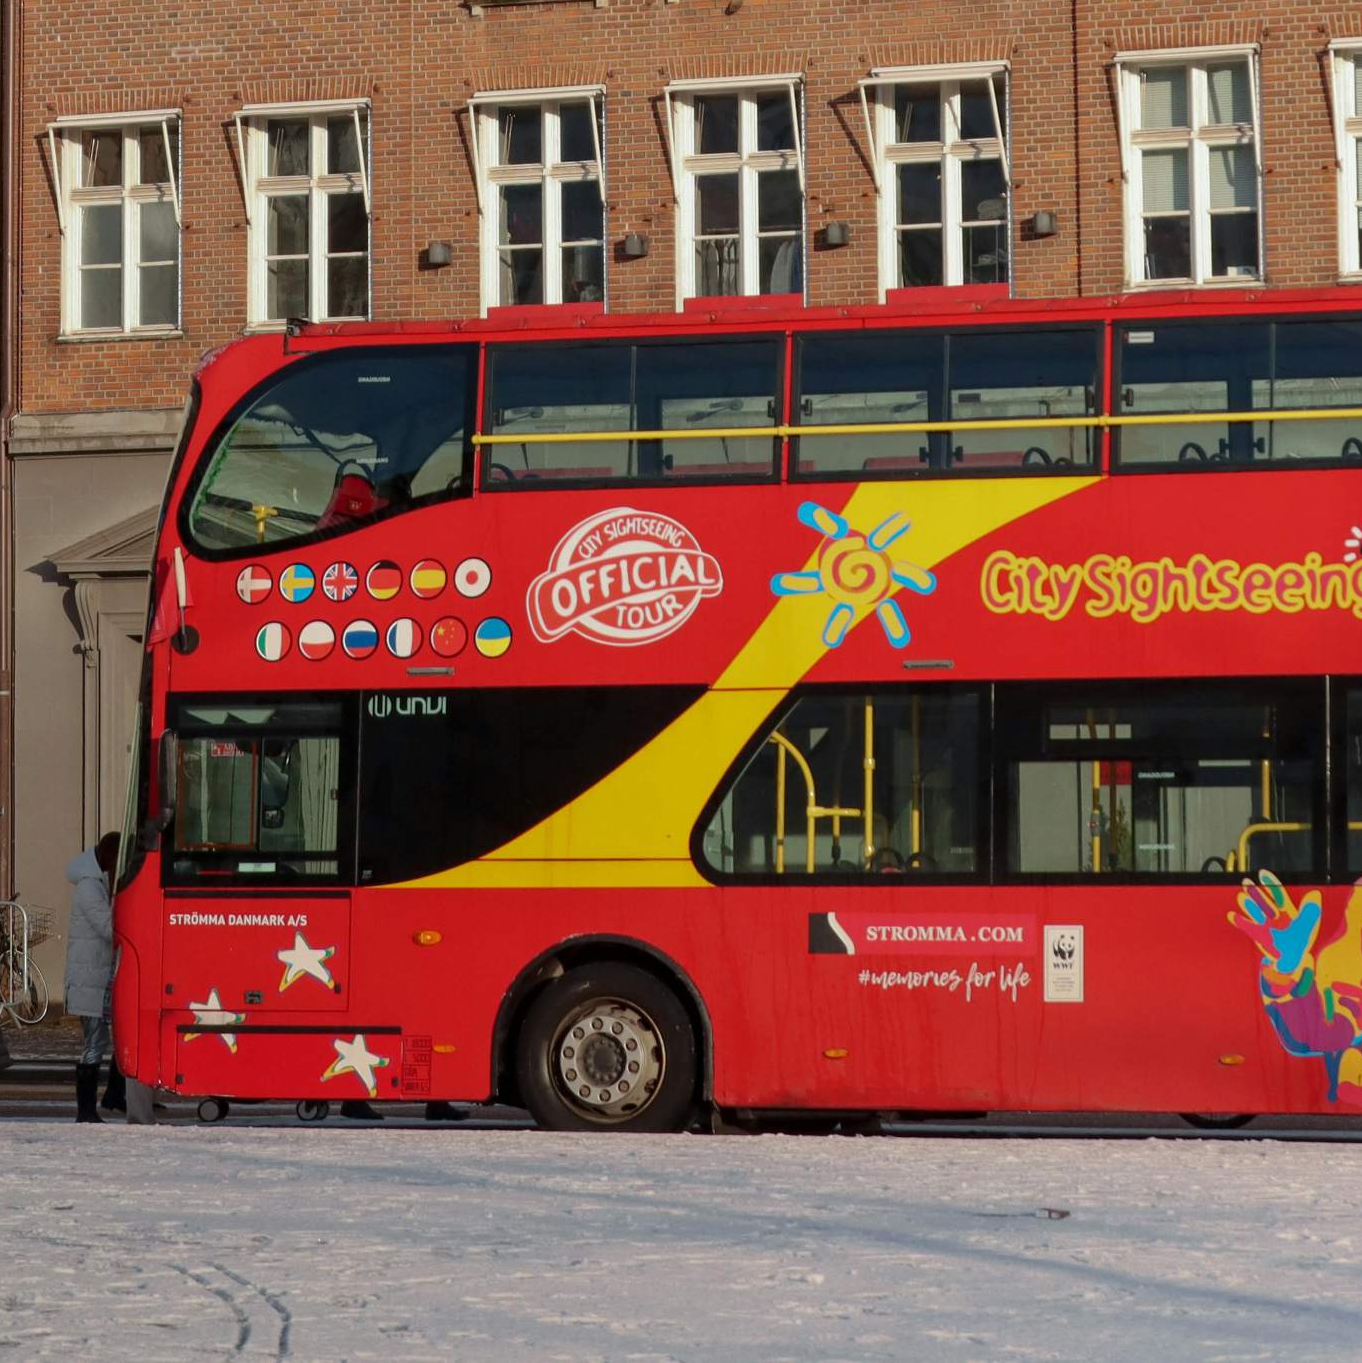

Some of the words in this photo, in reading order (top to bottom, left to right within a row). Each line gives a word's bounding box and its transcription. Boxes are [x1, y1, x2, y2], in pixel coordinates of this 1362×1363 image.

[578, 530, 604, 559] CITY
[603, 517, 686, 548] SIGHTSEEING
[551, 554, 718, 618] OFFICIAL
[616, 593, 685, 629] TOUR
[169, 911, 226, 926] STRÖMMA
[228, 914, 286, 927] DANMARK
[287, 913, 308, 927] A/S
[857, 968, 963, 991] #memories
[965, 961, 995, 1003] for
[999, 961, 1031, 1003] life
